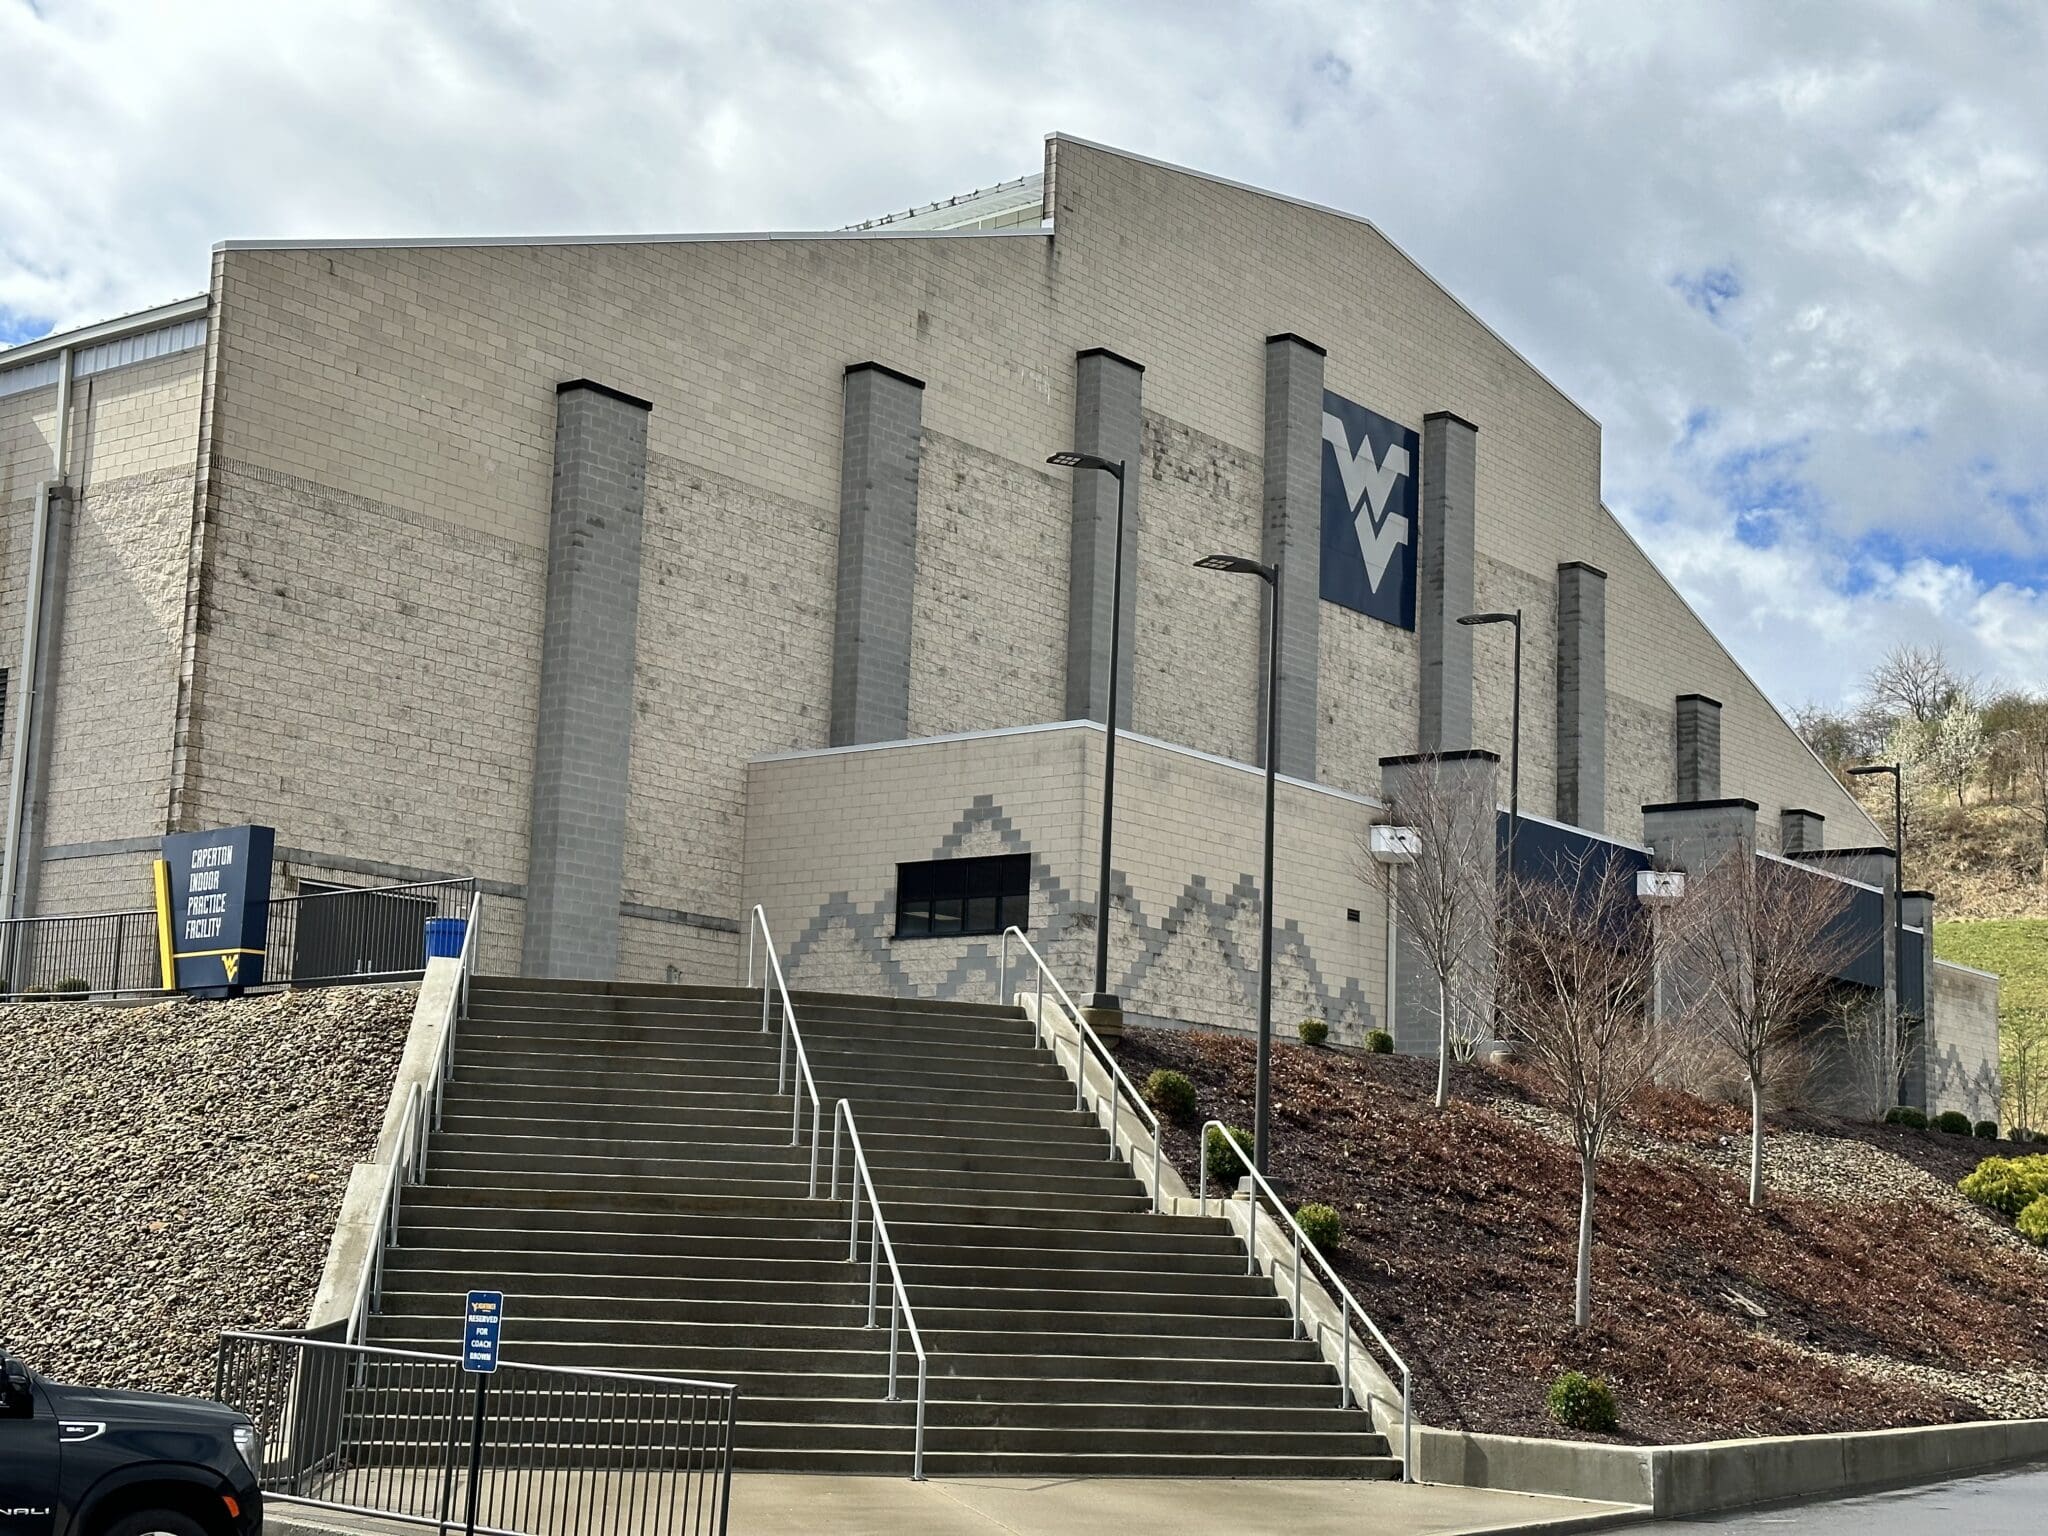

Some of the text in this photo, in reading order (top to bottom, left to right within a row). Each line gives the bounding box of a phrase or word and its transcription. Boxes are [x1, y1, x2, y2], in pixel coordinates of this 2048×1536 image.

[191, 845, 233, 869] CAPERTON
[189, 870, 220, 892] INDOOR
[187, 893, 227, 916] PRACTICE
[185, 917, 222, 940] FACILITY
[468, 1314, 498, 1324] RESERVED
[475, 1327, 489, 1336] FOR
[470, 1339, 492, 1348] COACH
[469, 1352, 491, 1361] BROWN
